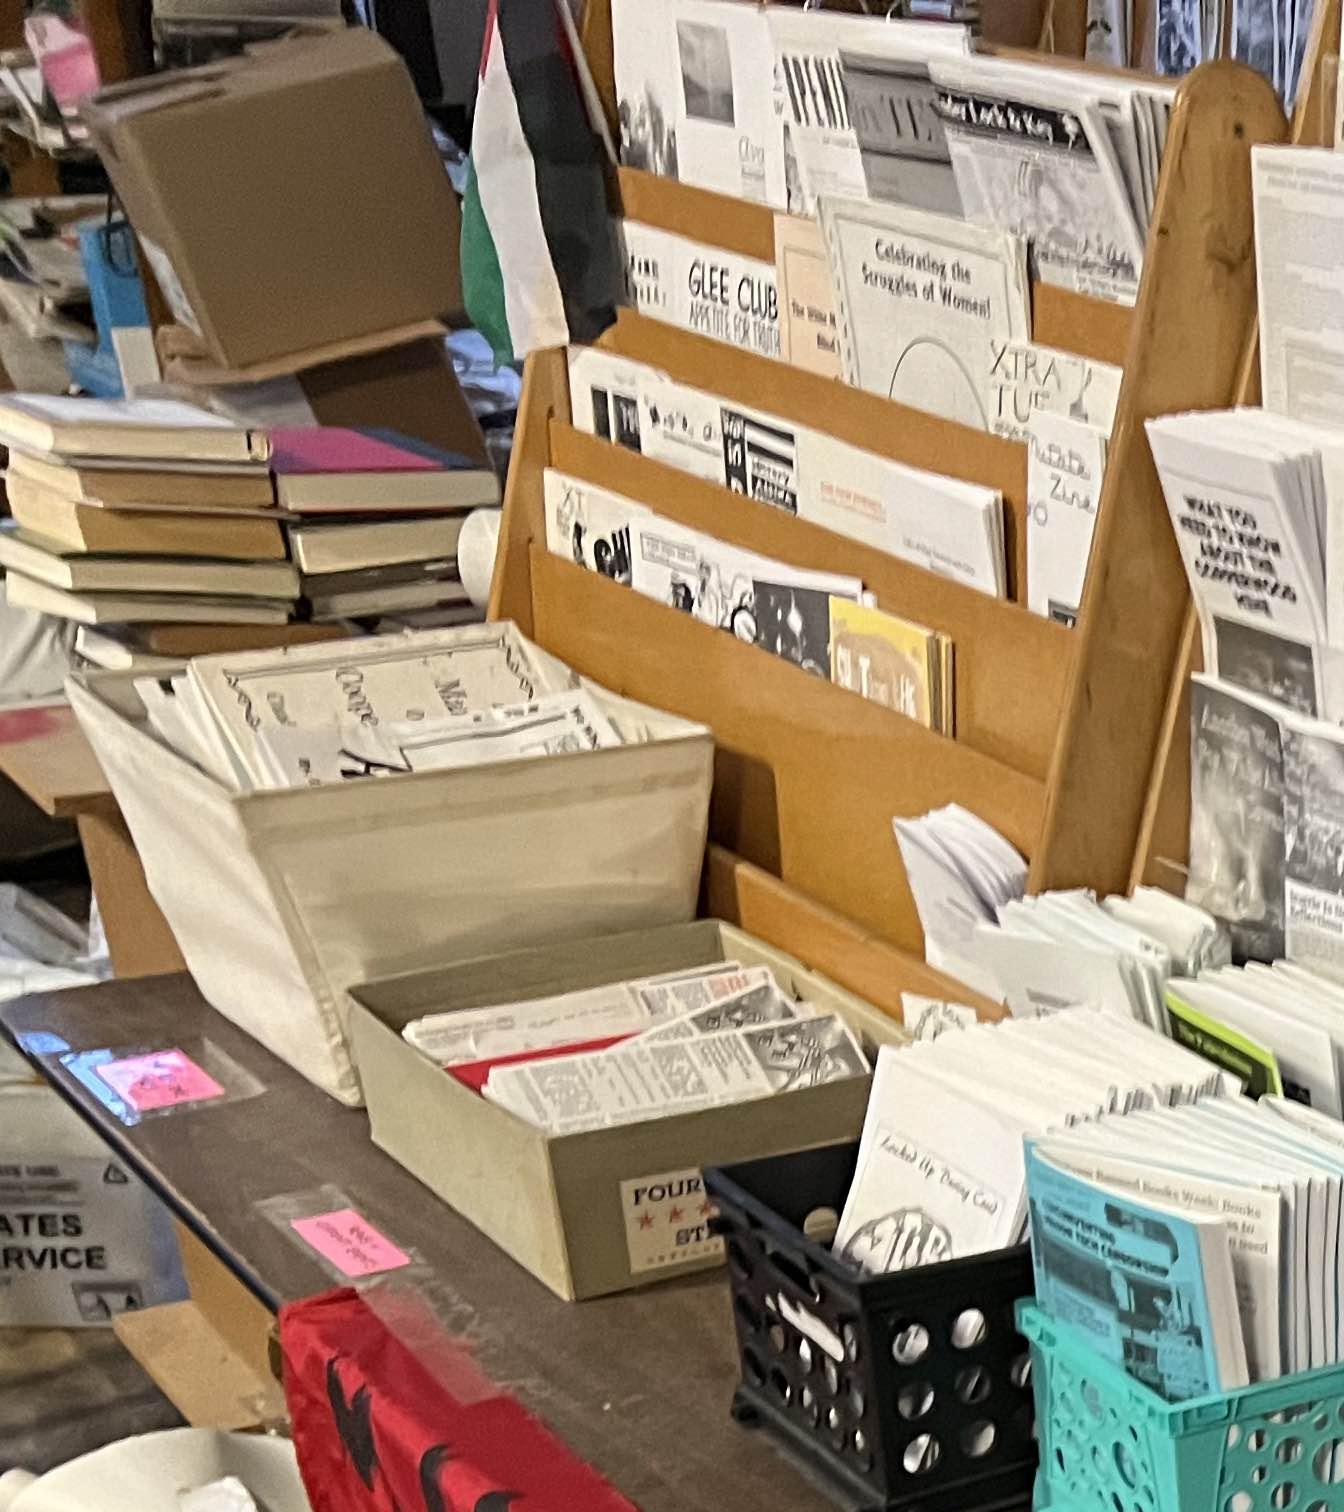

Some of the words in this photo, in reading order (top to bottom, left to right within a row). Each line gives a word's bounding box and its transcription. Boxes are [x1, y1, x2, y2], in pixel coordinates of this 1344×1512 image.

[861, 260, 918, 299] Struggles
[922, 279, 934, 301] of
[874, 238, 947, 282] Celebrating
[951, 259, 971, 285] the
[687, 257, 730, 306] GLEE
[737, 273, 779, 321] CLUB
[989, 339, 1061, 391] XTRA
[634, 1178, 702, 1206] FOUR
[0, 1213, 83, 1237] ATES
[2, 1246, 107, 1271] RVICE
